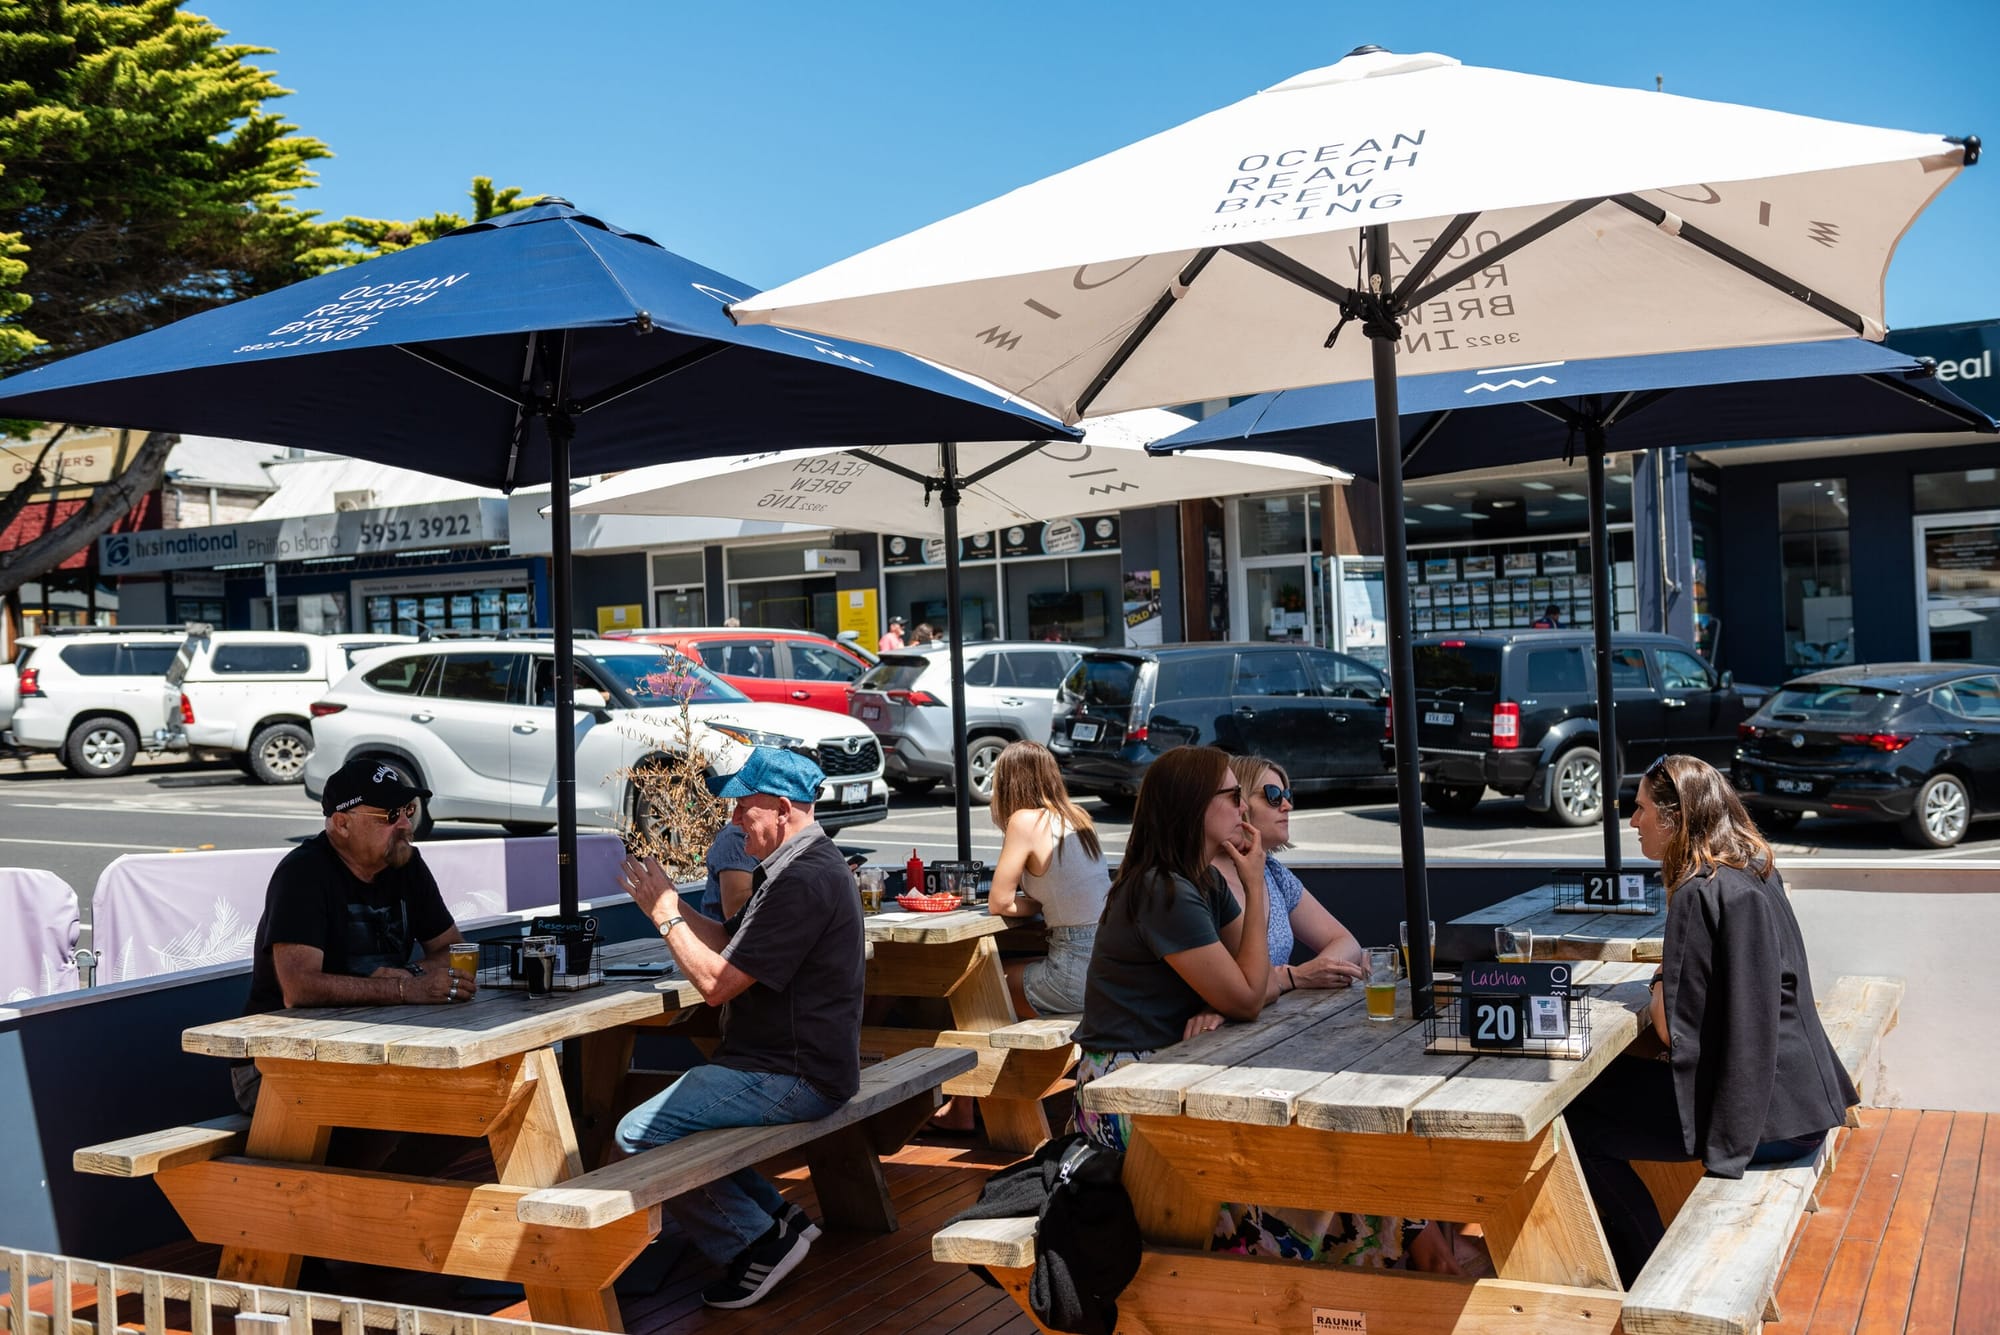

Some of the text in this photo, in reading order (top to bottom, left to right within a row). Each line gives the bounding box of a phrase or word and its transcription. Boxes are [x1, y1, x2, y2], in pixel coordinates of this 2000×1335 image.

[1238, 129, 1426, 172] OCEAN
[1227, 151, 1418, 194] REACH
[1214, 178, 1373, 214] BREW
[1287, 193, 1404, 222] ING
[339, 272, 470, 300] OCEAN
[304, 291, 439, 318] REACH
[268, 312, 384, 336] BREW
[283, 326, 372, 348] ING
[1916, 350, 1991, 382] eal
[294, 531, 341, 553] Island
[360, 520, 412, 545] 5952
[419, 514, 471, 539] 3922
[1127, 610, 1150, 626] SOLD
[926, 874, 937, 894] 9
[1590, 877, 1614, 901] 21
[1470, 969, 1527, 987] Lachlan
[1476, 1004, 1516, 1041] 20
[1316, 1316, 1362, 1328] RAUNIK
